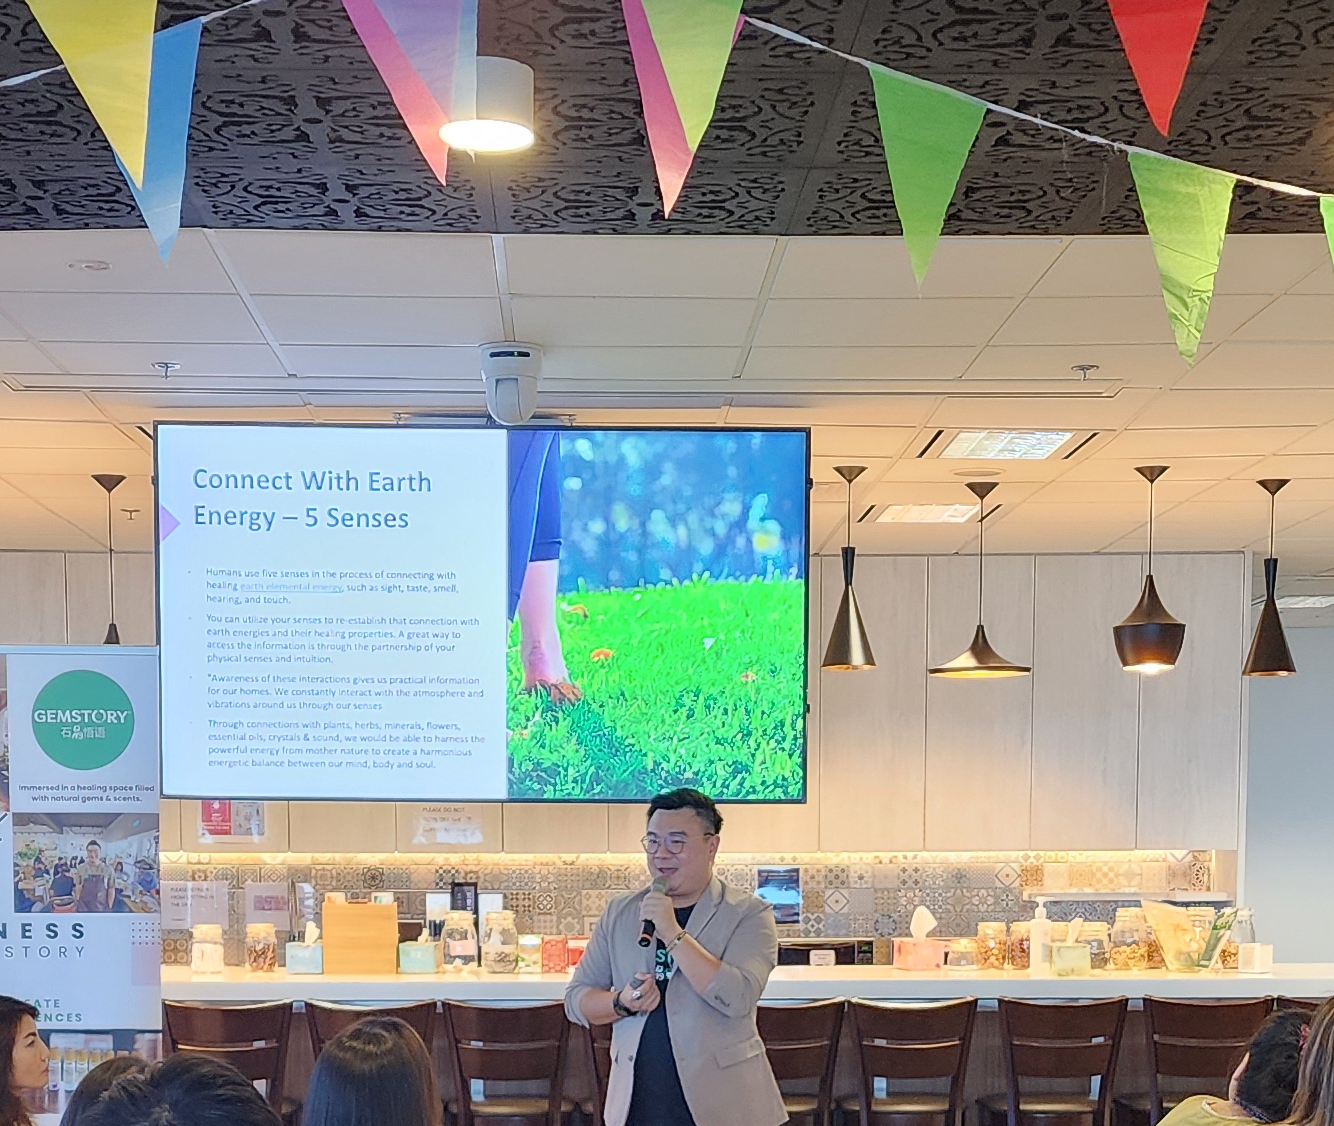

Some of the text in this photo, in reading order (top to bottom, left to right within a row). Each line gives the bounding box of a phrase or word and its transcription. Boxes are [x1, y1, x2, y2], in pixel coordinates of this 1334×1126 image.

[192, 468, 431, 492] Connect With Earth
[193, 505, 276, 532] Energy
[305, 507, 318, 527] 5
[327, 508, 409, 528] Senses
[206, 568, 242, 577] Humans
[262, 569, 278, 578] five
[312, 570, 320, 578] in
[321, 569, 337, 578] the
[339, 572, 373, 581] process
[374, 570, 384, 579] of
[386, 571, 435, 581] connecting
[436, 570, 456, 579] with
[206, 581, 238, 592] healing
[240, 581, 263, 590] earth
[266, 582, 310, 591] elemental
[346, 583, 367, 592] such
[244, 594, 261, 603] and
[206, 613, 223, 622] You
[270, 616, 290, 625] your
[324, 615, 333, 624] to
[335, 615, 387, 624] re-establish
[389, 615, 407, 624] that
[409, 617, 458, 625] connection
[460, 616, 480, 625] with
[206, 627, 230, 636] earth
[271, 628, 288, 637] and
[290, 628, 312, 637] their
[314, 628, 346, 639] healing
[398, 629, 405, 638] A
[407, 630, 430, 640] great
[431, 632, 450, 640] way
[452, 630, 461, 638] to
[237, 641, 252, 650] the
[254, 641, 306, 650] information
[308, 642, 315, 650] is
[317, 641, 353, 653] through
[354, 641, 369, 650] the
[371, 642, 422, 653] partnership
[424, 642, 434, 651] of
[435, 645, 456, 653] your
[207, 653, 242, 665] physical
[275, 654, 292, 663] and
[261, 674, 271, 683] of
[272, 674, 297, 683] these
[298, 675, 351, 683] interactions
[353, 675, 375, 686] gives
[389, 675, 426, 686] practical
[428, 675, 480, 684] information
[207, 686, 220, 695] for
[274, 686, 290, 695] We
[291, 687, 336, 698] constantly
[338, 688, 372, 696] interact
[374, 687, 394, 696] with
[396, 687, 411, 696] the
[413, 688, 466, 699] atmosphere
[467, 688, 484, 697] and
[208, 699, 251, 708] vibrations
[253, 700, 284, 709] around
[299, 700, 334, 711] through
[33, 709, 127, 724] GEMSTORY
[208, 719, 244, 730] Through
[246, 720, 300, 728] connections
[301, 720, 321, 729] with
[208, 732, 246, 741] essential
[268, 732, 301, 743] crystals
[303, 732, 310, 741] &
[359, 733, 387, 742] would
[389, 733, 400, 742] be
[402, 733, 421, 742] able
[423, 734, 432, 742] to
[434, 733, 469, 742] harness
[470, 733, 486, 742] the
[208, 745, 248, 757] powerful
[249, 748, 280, 757] energy
[281, 746, 304, 755] from
[305, 746, 338, 755] mother
[340, 747, 369, 755] nature
[371, 747, 381, 755] to
[382, 747, 410, 755] create
[251, 758, 285, 767] balance
[287, 759, 326, 768] between
[372, 759, 395, 770] body
[397, 759, 413, 768] and
[19, 784, 59, 792] Immersed
[61, 784, 69, 792] in
[77, 784, 107, 793] healing
[135, 784, 155, 792] filled
